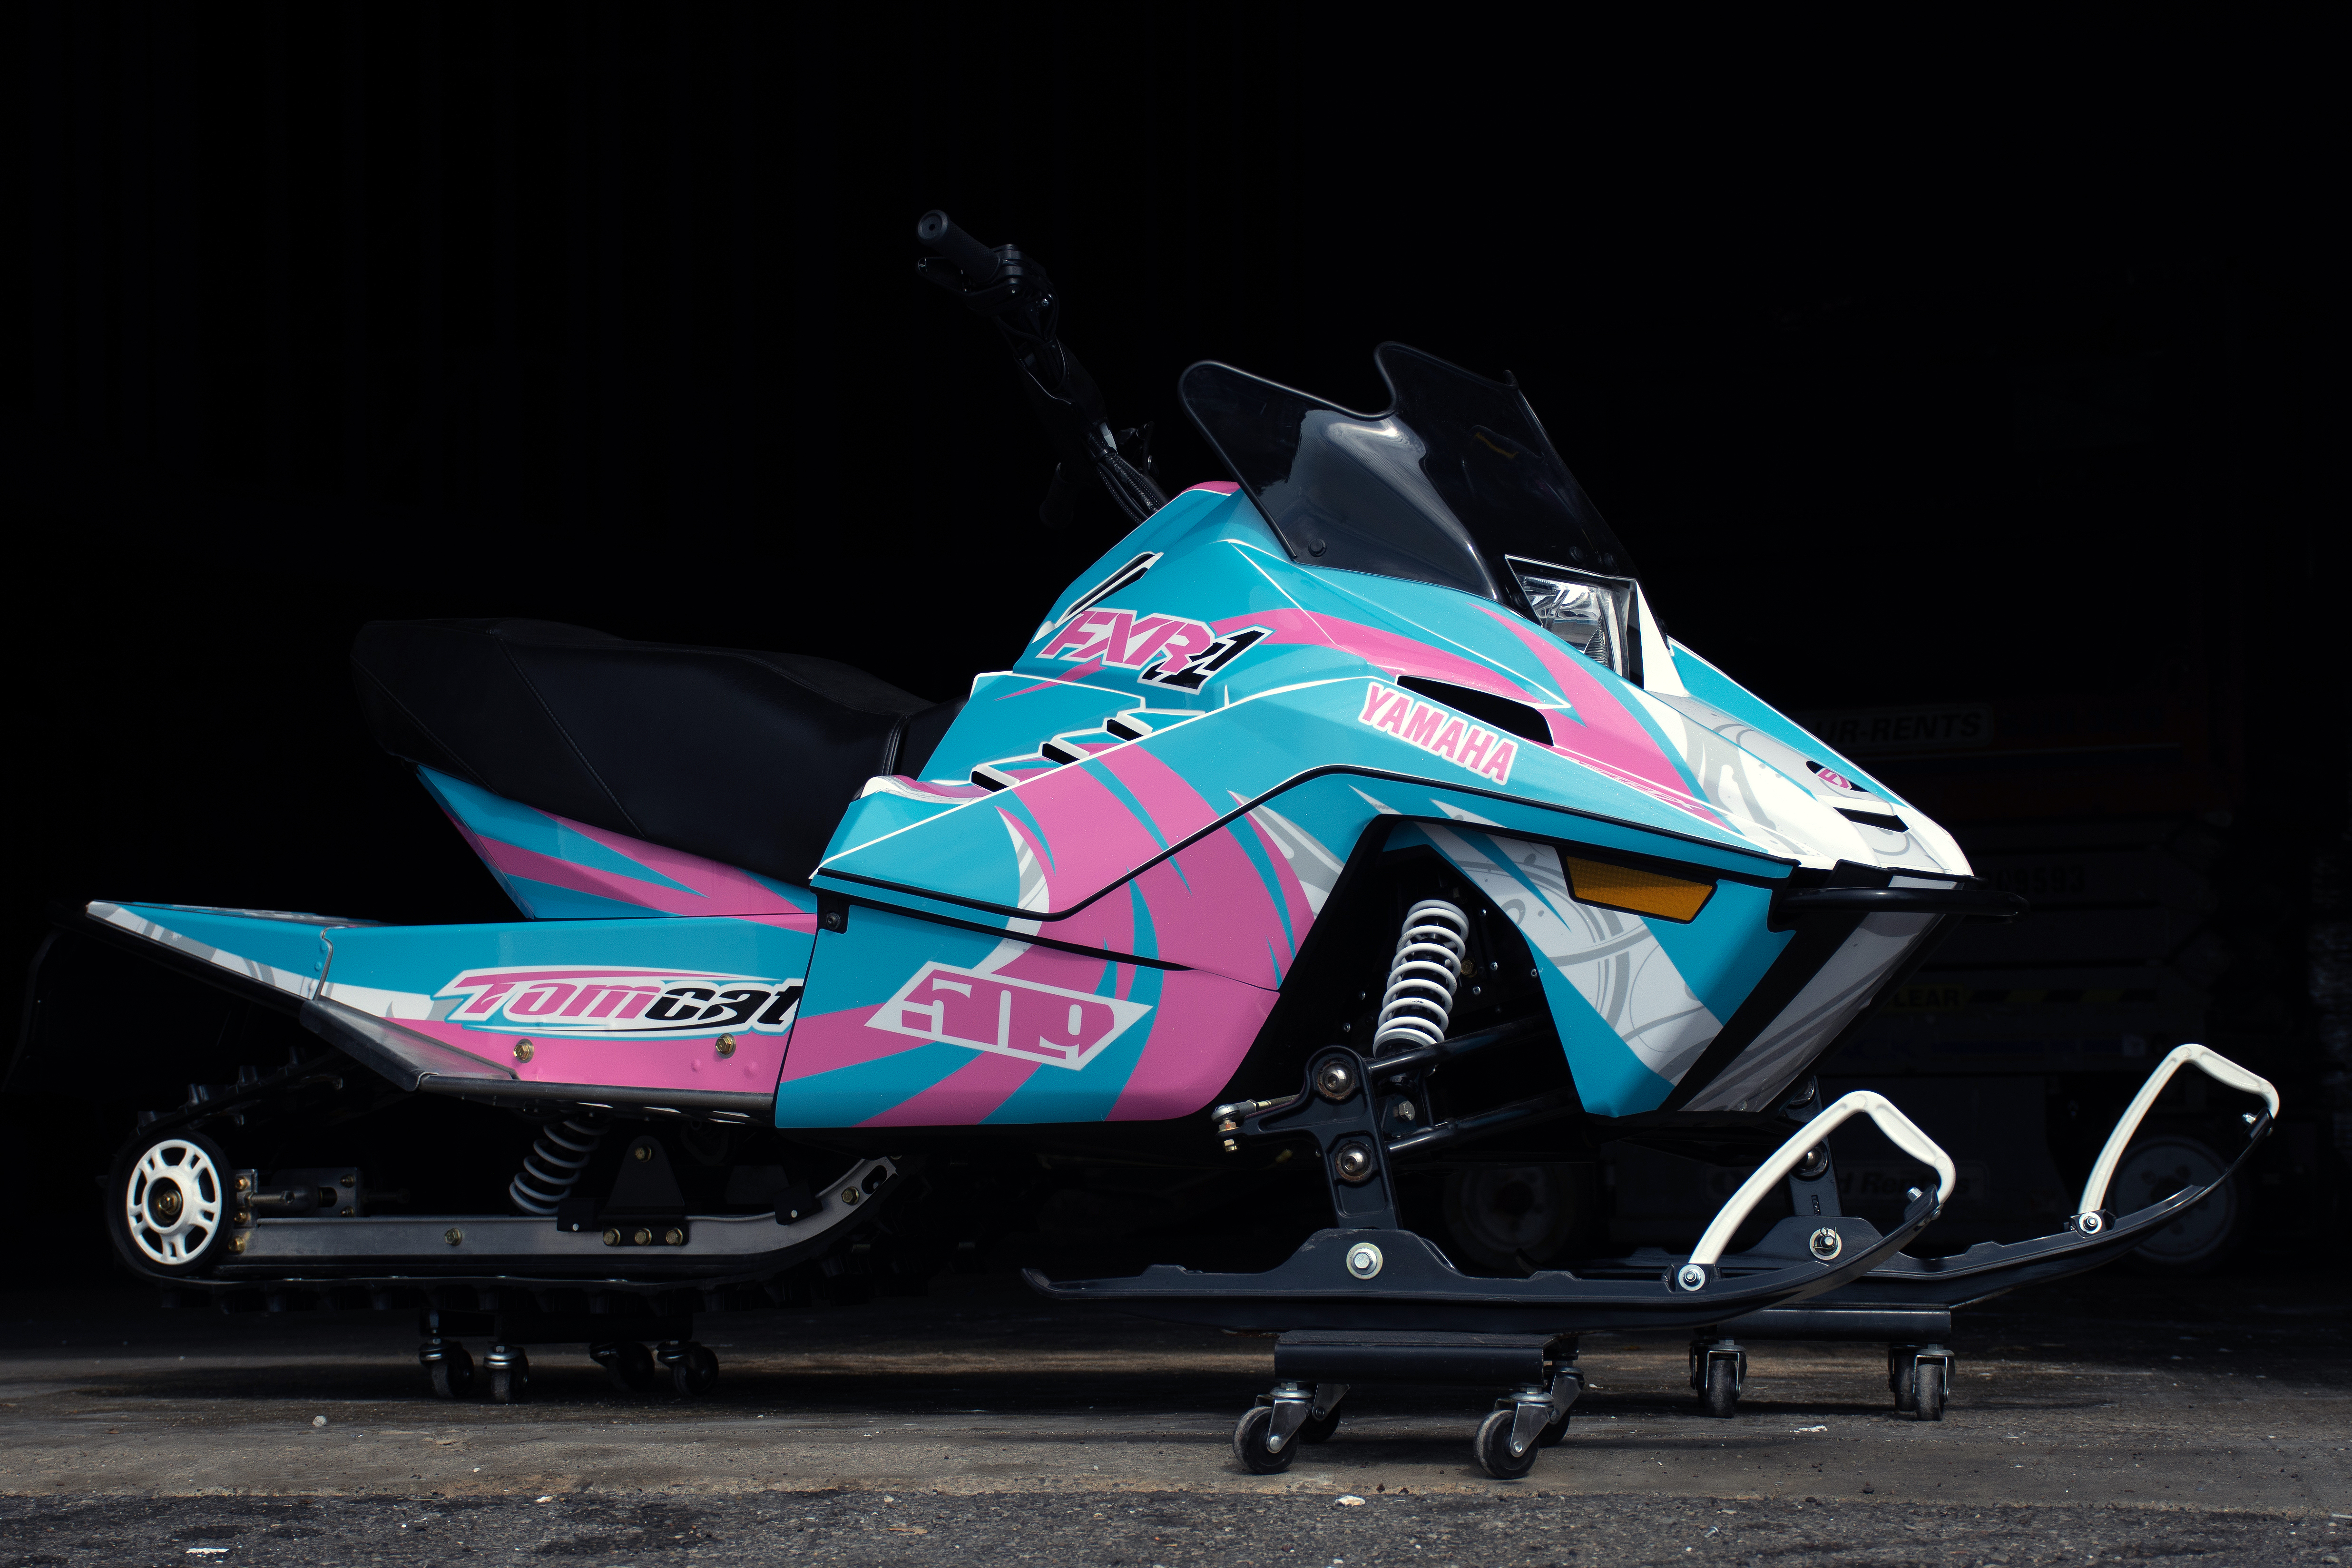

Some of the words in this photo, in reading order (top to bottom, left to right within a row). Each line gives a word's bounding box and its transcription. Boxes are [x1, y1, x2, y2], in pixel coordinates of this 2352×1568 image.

[1040, 610, 1212, 674] FXR
[1361, 684, 1516, 783] YAMAHA
[1890, 988, 1960, 1008] LEAR
